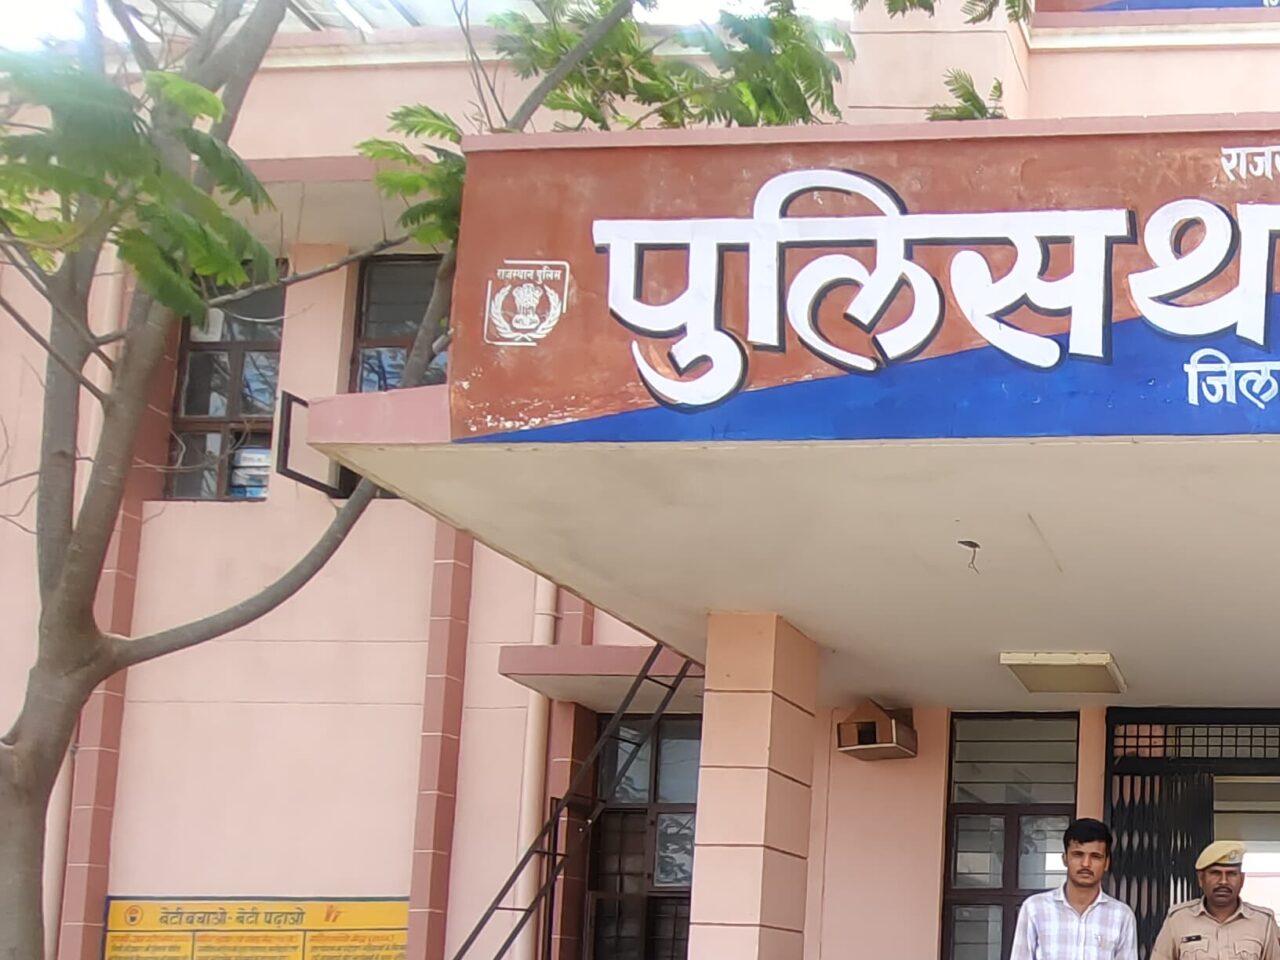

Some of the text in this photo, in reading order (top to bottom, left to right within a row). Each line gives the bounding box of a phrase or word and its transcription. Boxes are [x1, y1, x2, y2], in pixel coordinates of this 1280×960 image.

[592, 169, 1131, 408] पुलिस
[159, 906, 184, 925] बेटी
[236, 906, 260, 925] बेटी
